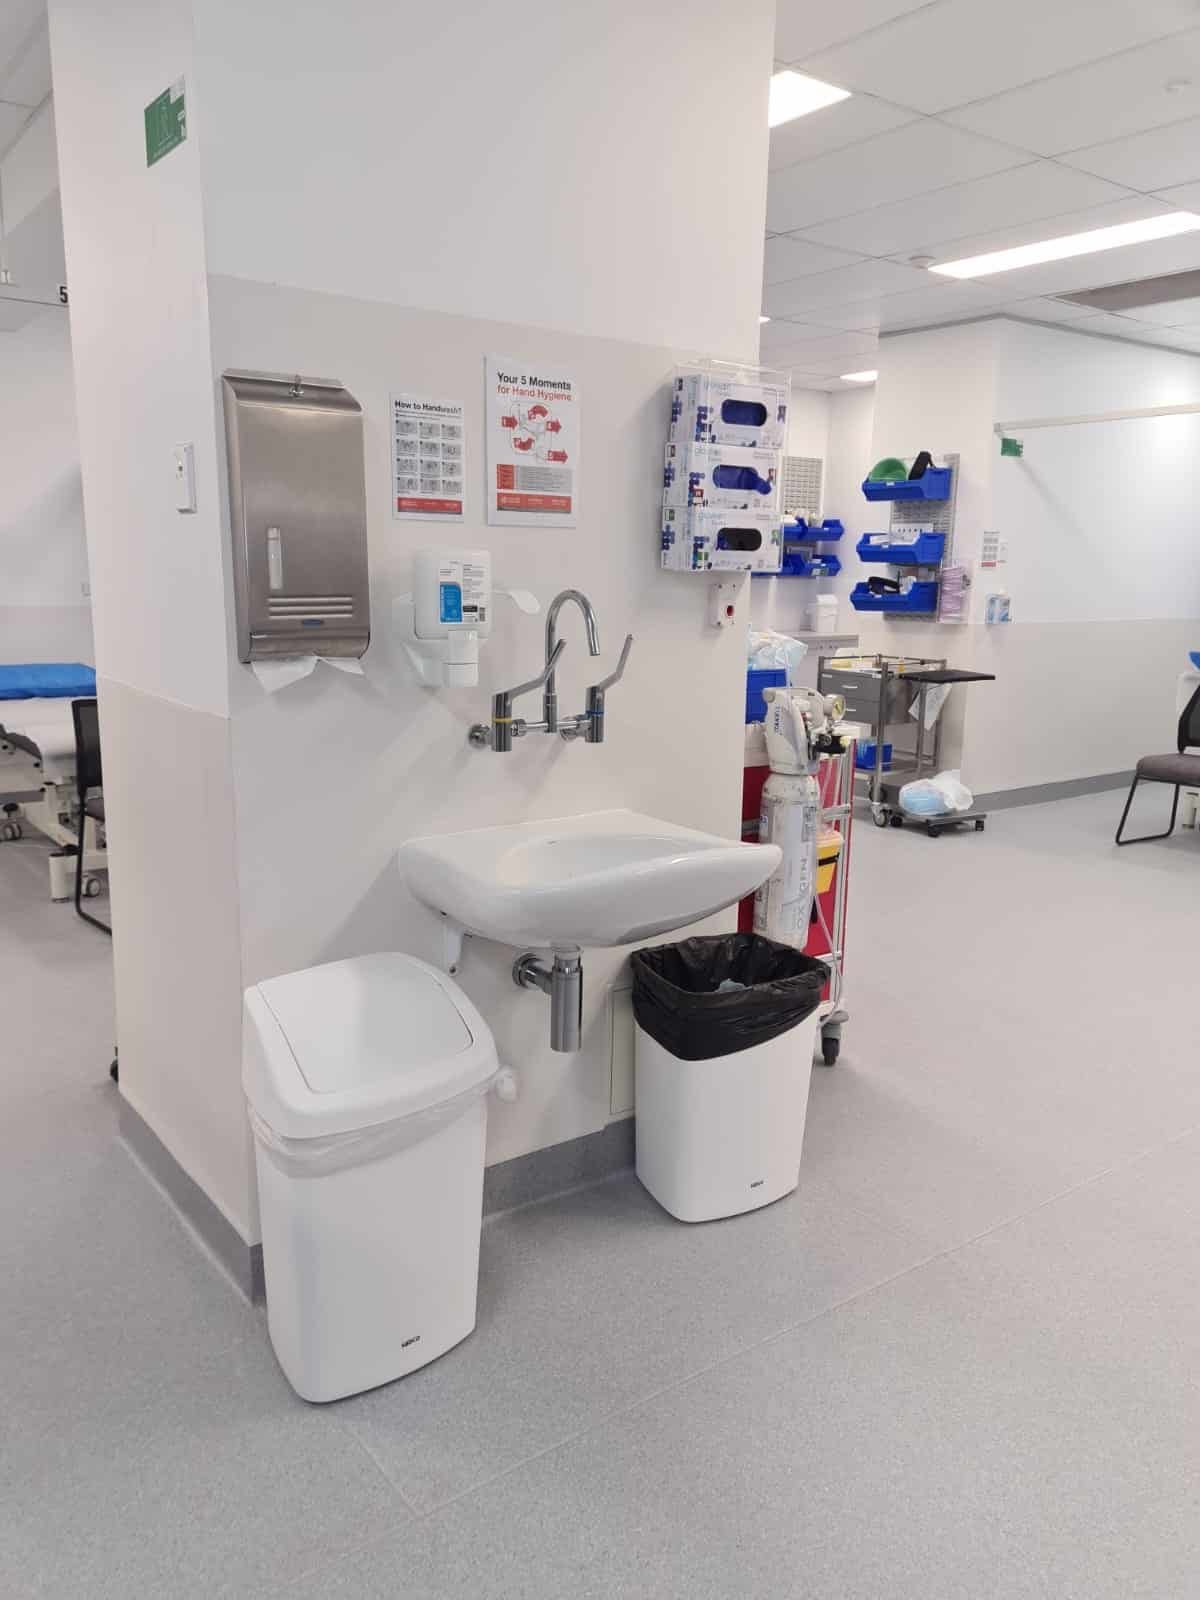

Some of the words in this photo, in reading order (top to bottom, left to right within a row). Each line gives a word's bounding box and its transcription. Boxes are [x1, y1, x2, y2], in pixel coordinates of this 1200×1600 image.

[60, 286, 68, 303] 5
[497, 372, 518, 384] Your
[521, 375, 527, 385] 5
[529, 376, 571, 391] Moments
[497, 385, 509, 394] for
[512, 386, 535, 397] Hand
[537, 389, 571, 401] Hygiene
[394, 400, 411, 408] How
[414, 402, 421, 410] to
